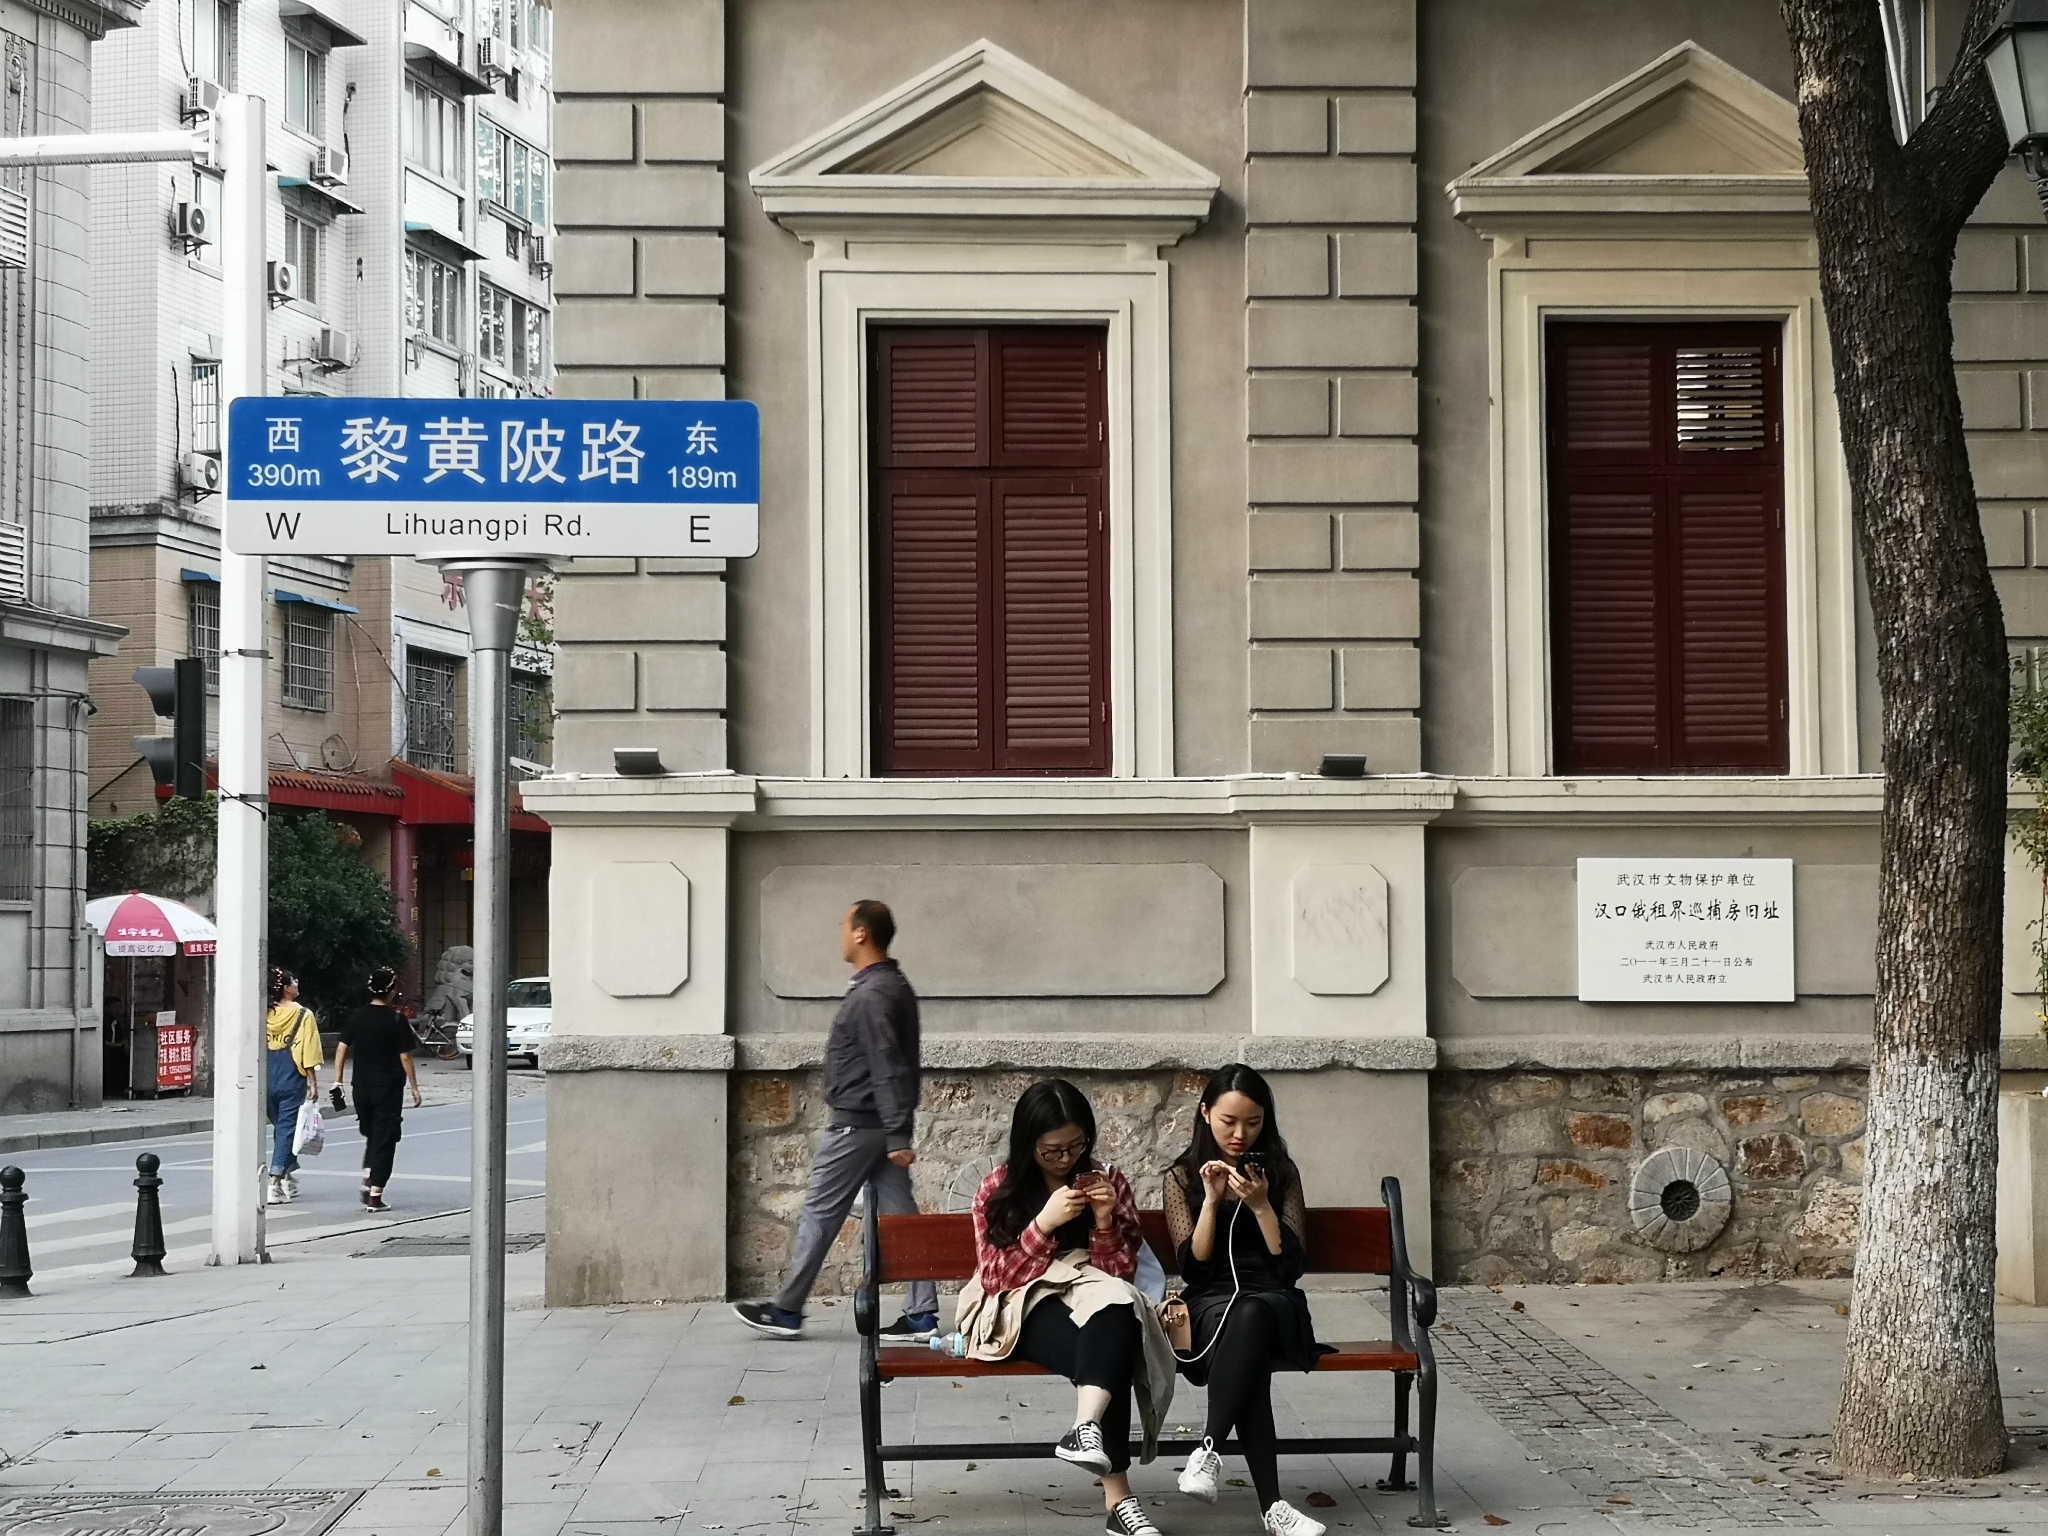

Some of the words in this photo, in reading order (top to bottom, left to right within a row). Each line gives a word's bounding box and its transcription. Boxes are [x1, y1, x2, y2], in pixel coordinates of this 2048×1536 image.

[265, 417, 302, 453] 西
[685, 420, 719, 456] 东
[339, 415, 646, 485] 黎黄陂路
[247, 463, 320, 487] 390m
[667, 466, 737, 490] 189m
[265, 512, 301, 540] W
[387, 513, 528, 542] Lihuangpi
[545, 514, 592, 537] Rd.
[690, 515, 711, 543] E
[1616, 873, 1756, 887] 武汉市文物保护单位
[1594, 898, 1780, 922] 汉口俄租界巡捕房旧址
[118, 944, 165, 953] 提高记忆力
[1644, 940, 1719, 951] 武汉市人民政府
[1642, 973, 1727, 984] 武汉市人民政府立
[160, 1029, 191, 1045] 社区服务
